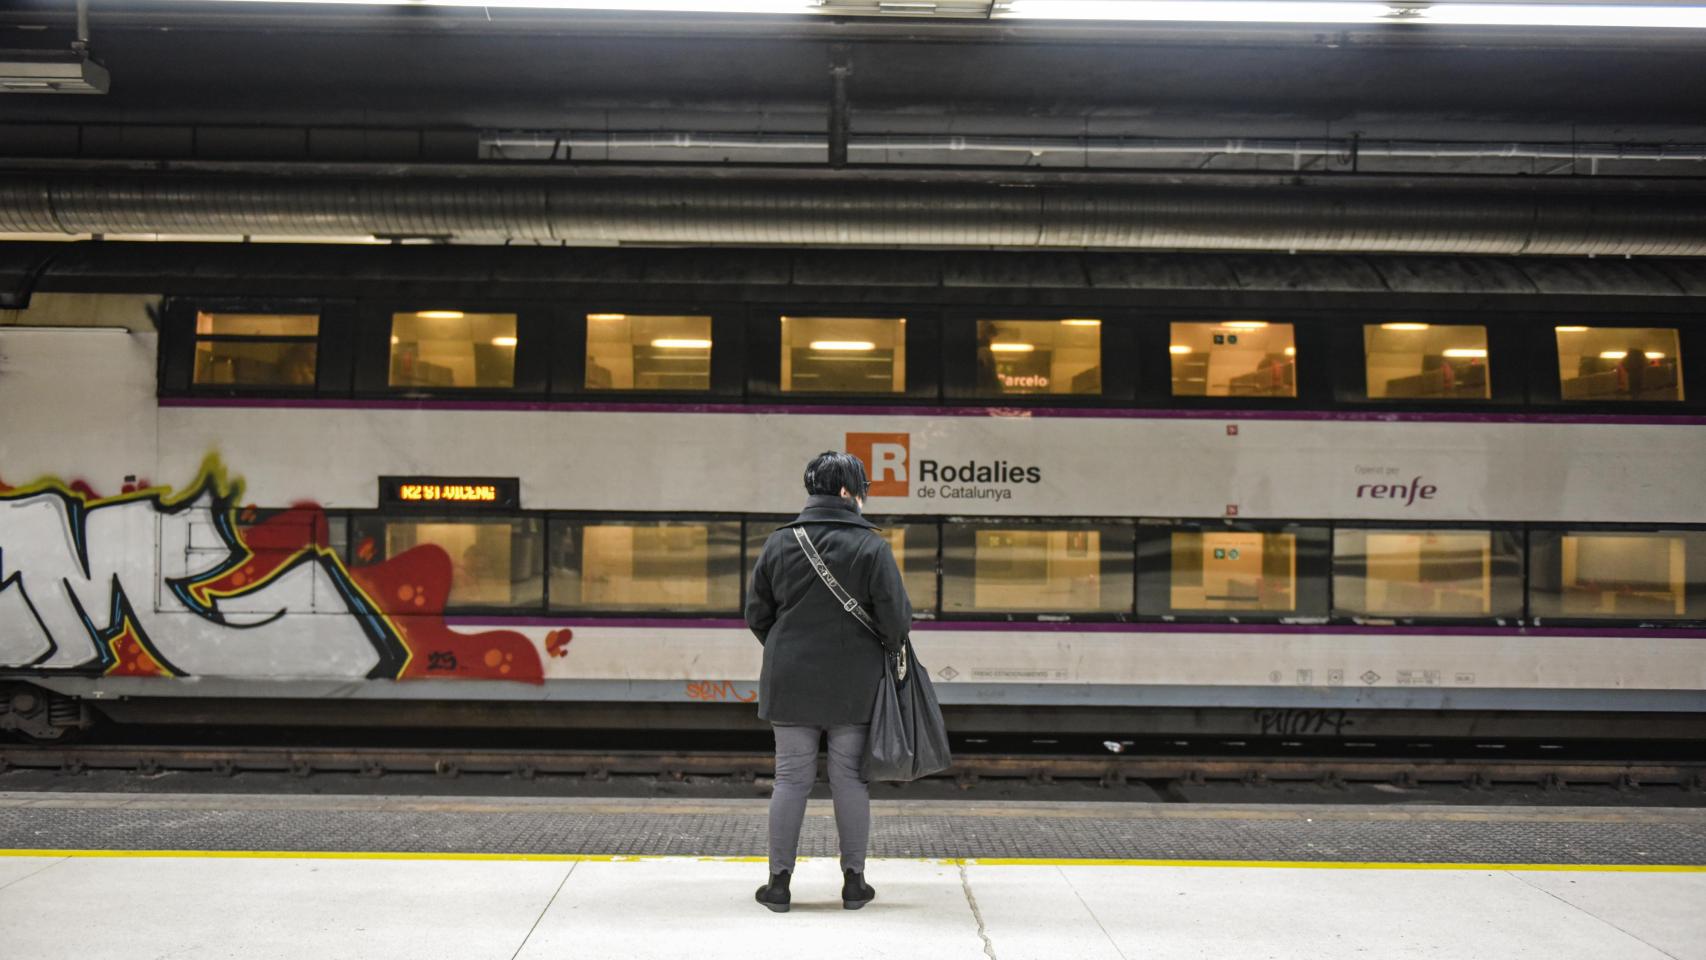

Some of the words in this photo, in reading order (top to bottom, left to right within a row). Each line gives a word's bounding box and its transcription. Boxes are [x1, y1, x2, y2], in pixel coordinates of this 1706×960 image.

[872, 443, 907, 482] R
[919, 459, 1041, 484] Rodalies
[917, 486, 936, 499] de
[939, 484, 1012, 502] Catalunya
[1356, 475, 1438, 508] renfe
